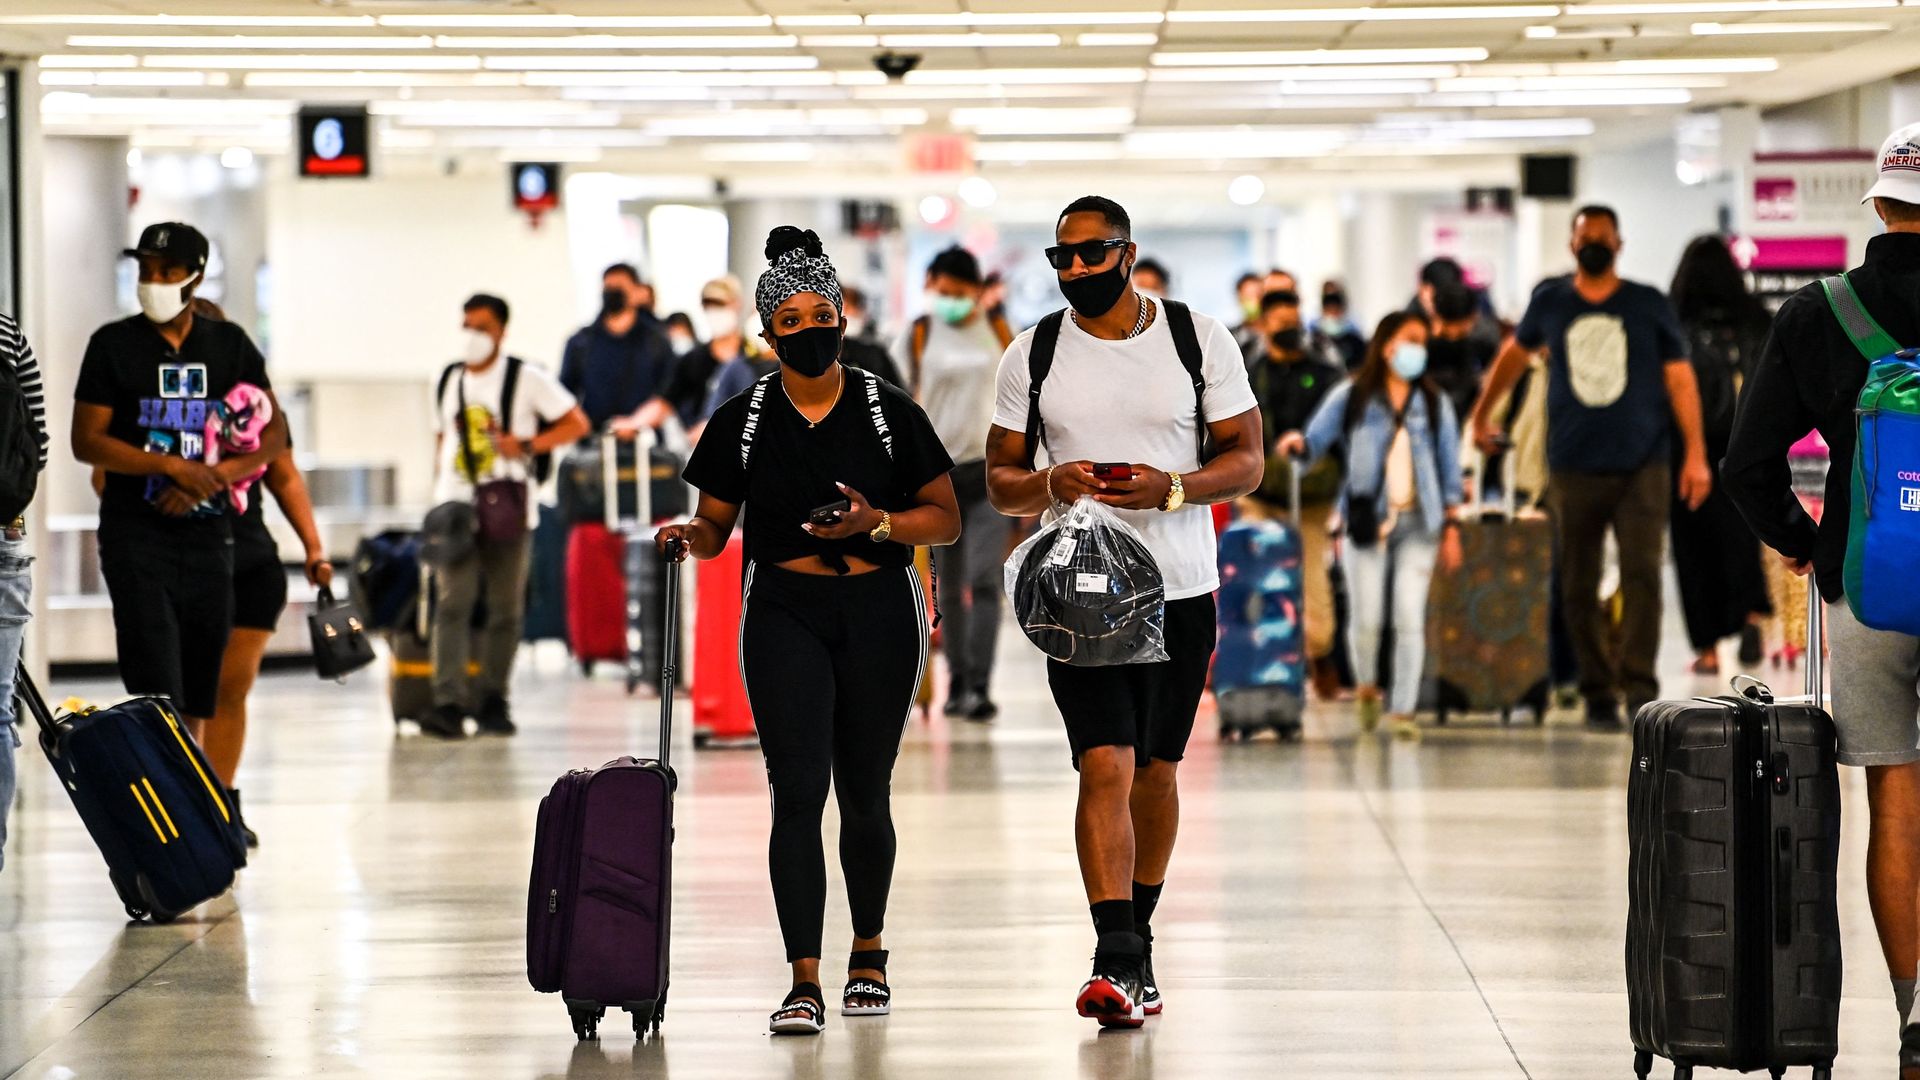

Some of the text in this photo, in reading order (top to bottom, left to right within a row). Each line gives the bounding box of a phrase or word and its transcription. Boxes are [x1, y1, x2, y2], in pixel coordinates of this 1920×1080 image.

[313, 117, 344, 160] 6
[750, 383, 767, 409] PINK
[865, 379, 880, 404] PINK
[742, 412, 760, 441] PINK
[870, 405, 890, 435] PINK
[844, 982, 889, 996] adidas
[783, 1001, 818, 1014] didas
